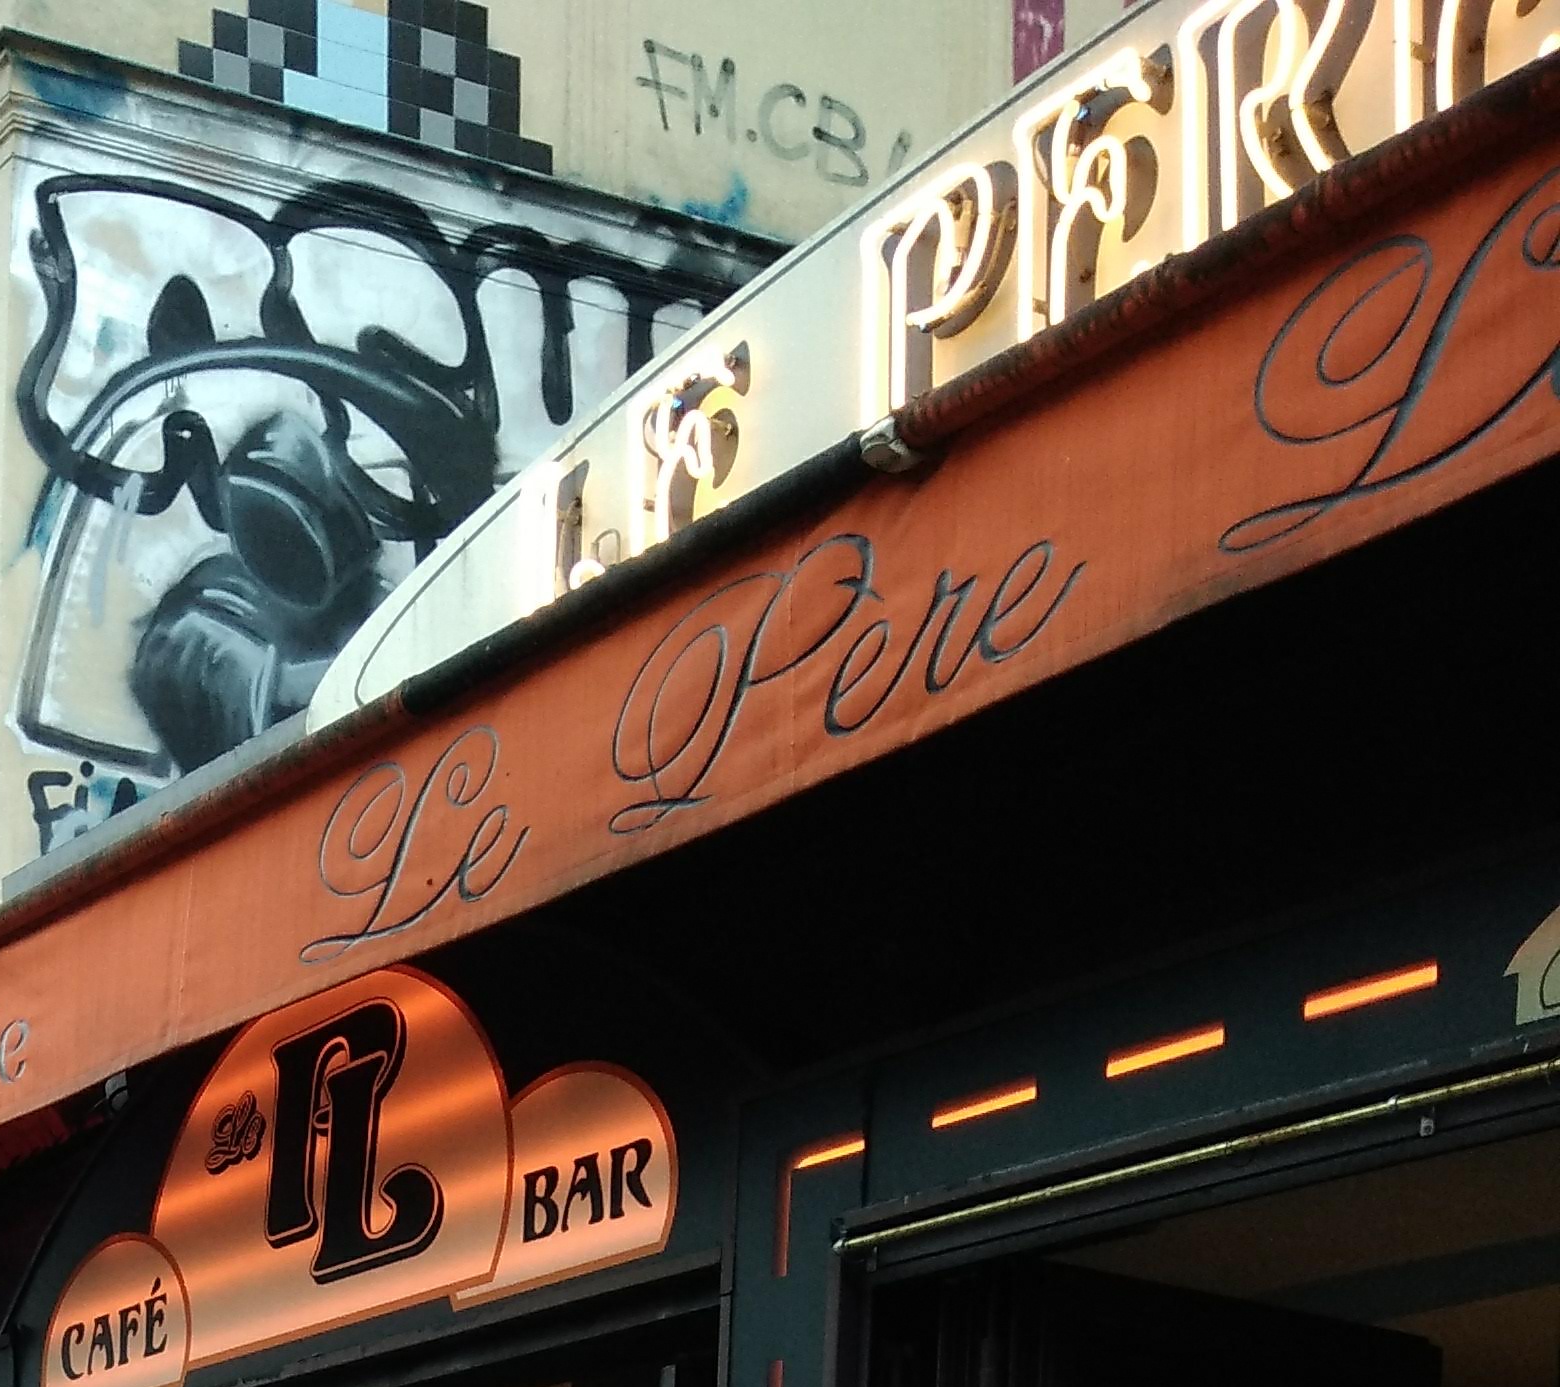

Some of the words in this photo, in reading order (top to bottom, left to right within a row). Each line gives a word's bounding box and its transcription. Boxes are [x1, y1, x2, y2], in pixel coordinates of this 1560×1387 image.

[300, 722, 532, 966] Le
[522, 1136, 654, 1245] BAR
[60, 1275, 170, 1383] CAFÉ
